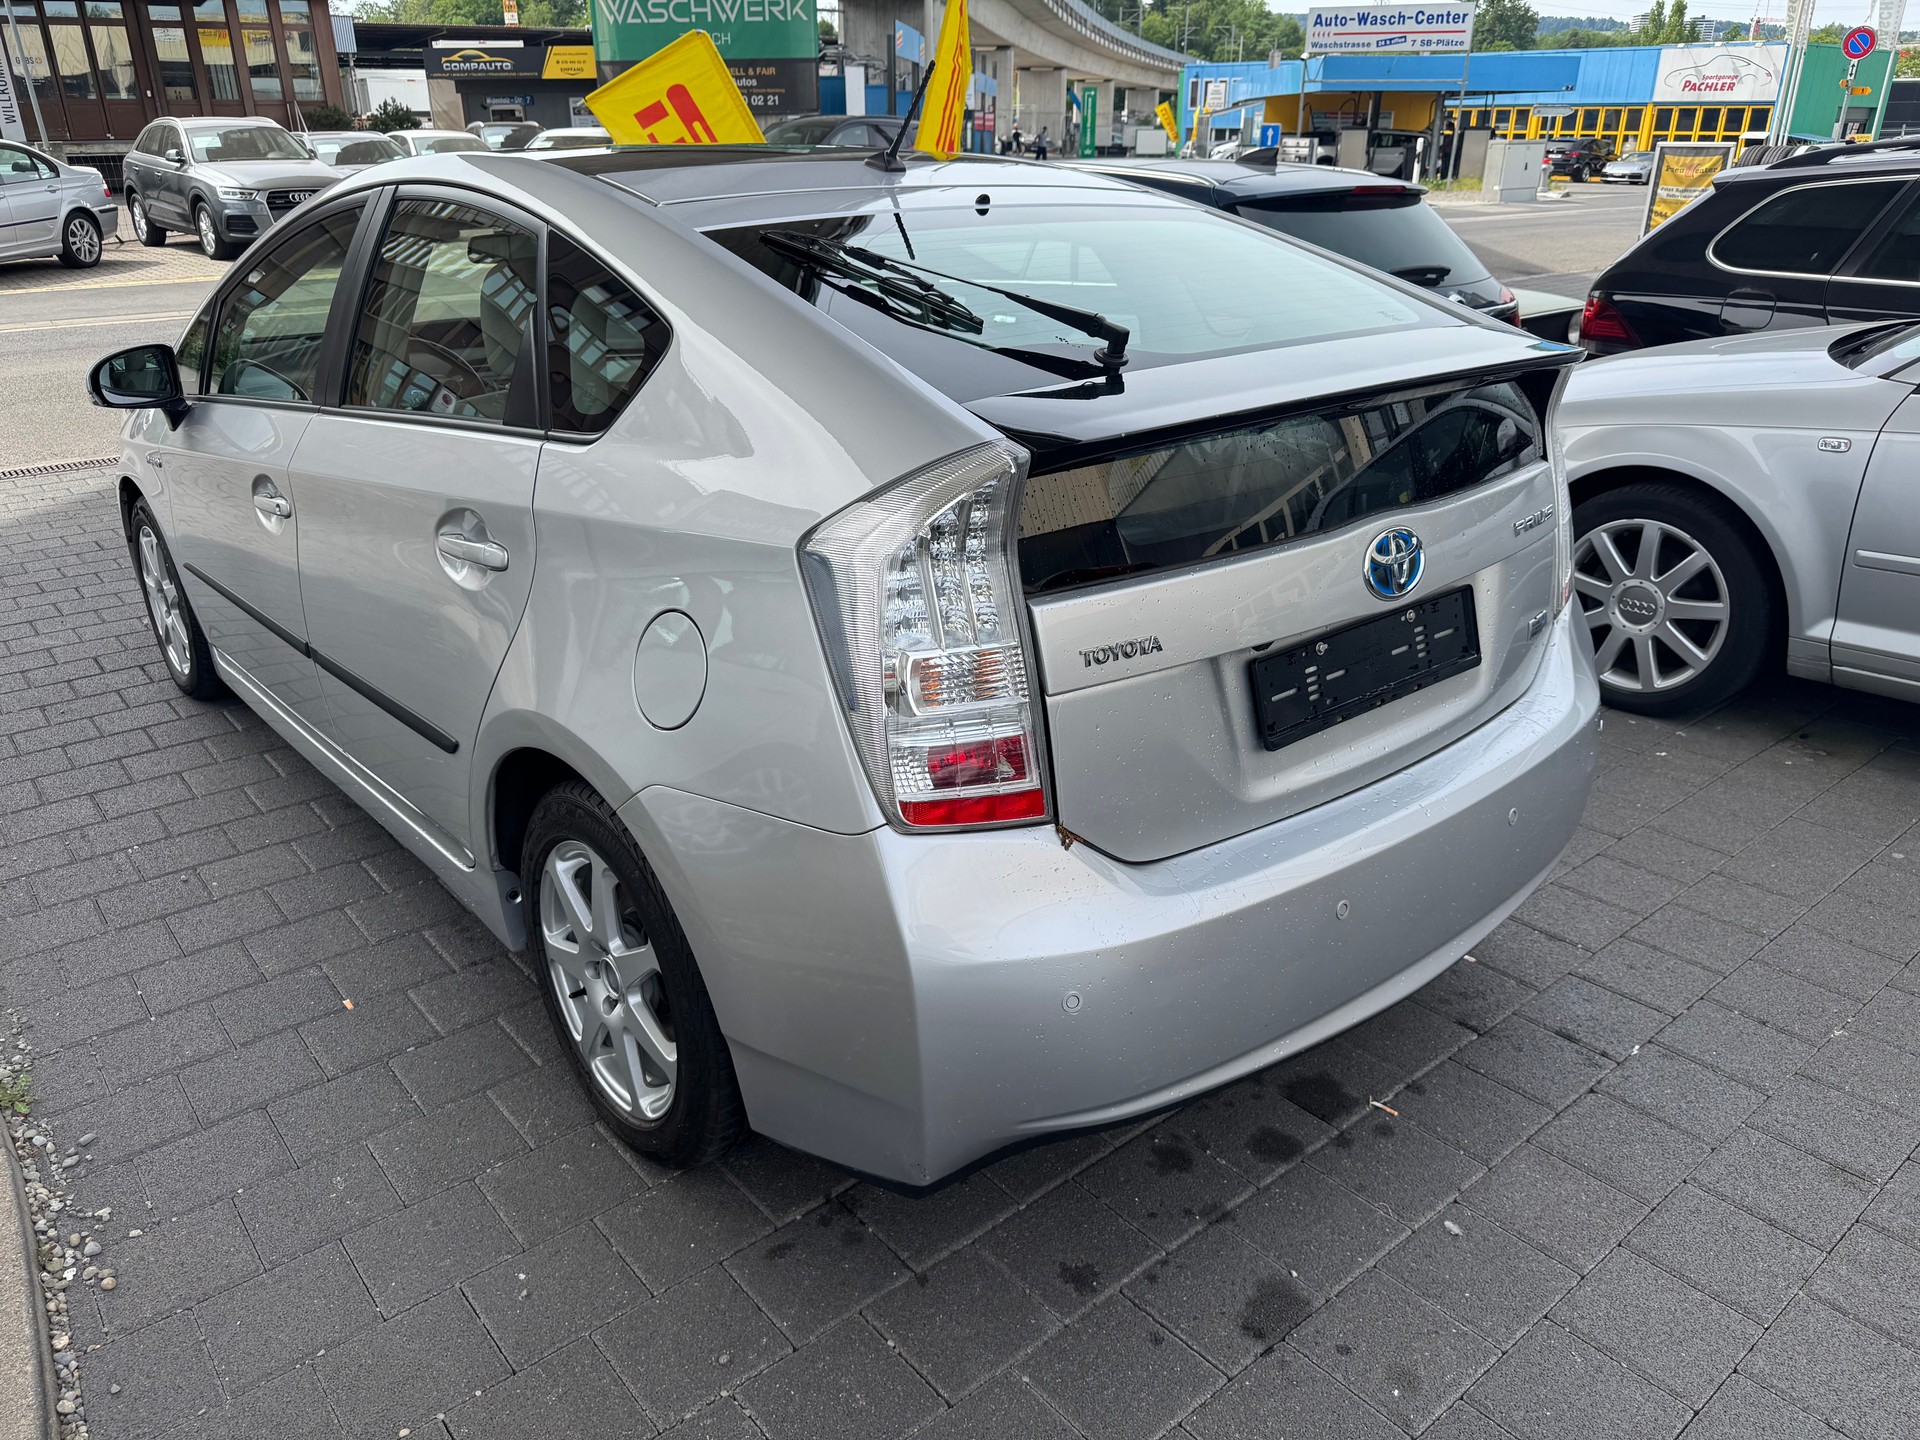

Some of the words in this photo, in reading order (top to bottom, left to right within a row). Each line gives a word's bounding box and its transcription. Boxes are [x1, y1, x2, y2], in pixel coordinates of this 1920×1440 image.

[600, 0, 808, 25] WASCHWERK
[1313, 10, 1469, 27] Auto-Wasch-Center
[1311, 41, 1371, 49] Waschstrasse
[1411, 39, 1417, 47] 7
[1420, 38, 1465, 47] SB-Plätze
[443, 62, 512, 71] COMPAUTO
[756, 67, 776, 75] FAIR
[1702, 74, 1739, 82] Sportgarage
[1682, 80, 1736, 92] PACHLER
[751, 95, 764, 106] 02
[767, 94, 779, 106] 21
[1513, 503, 1553, 537] PRIUS
[1079, 635, 1163, 668] TOYOTA
